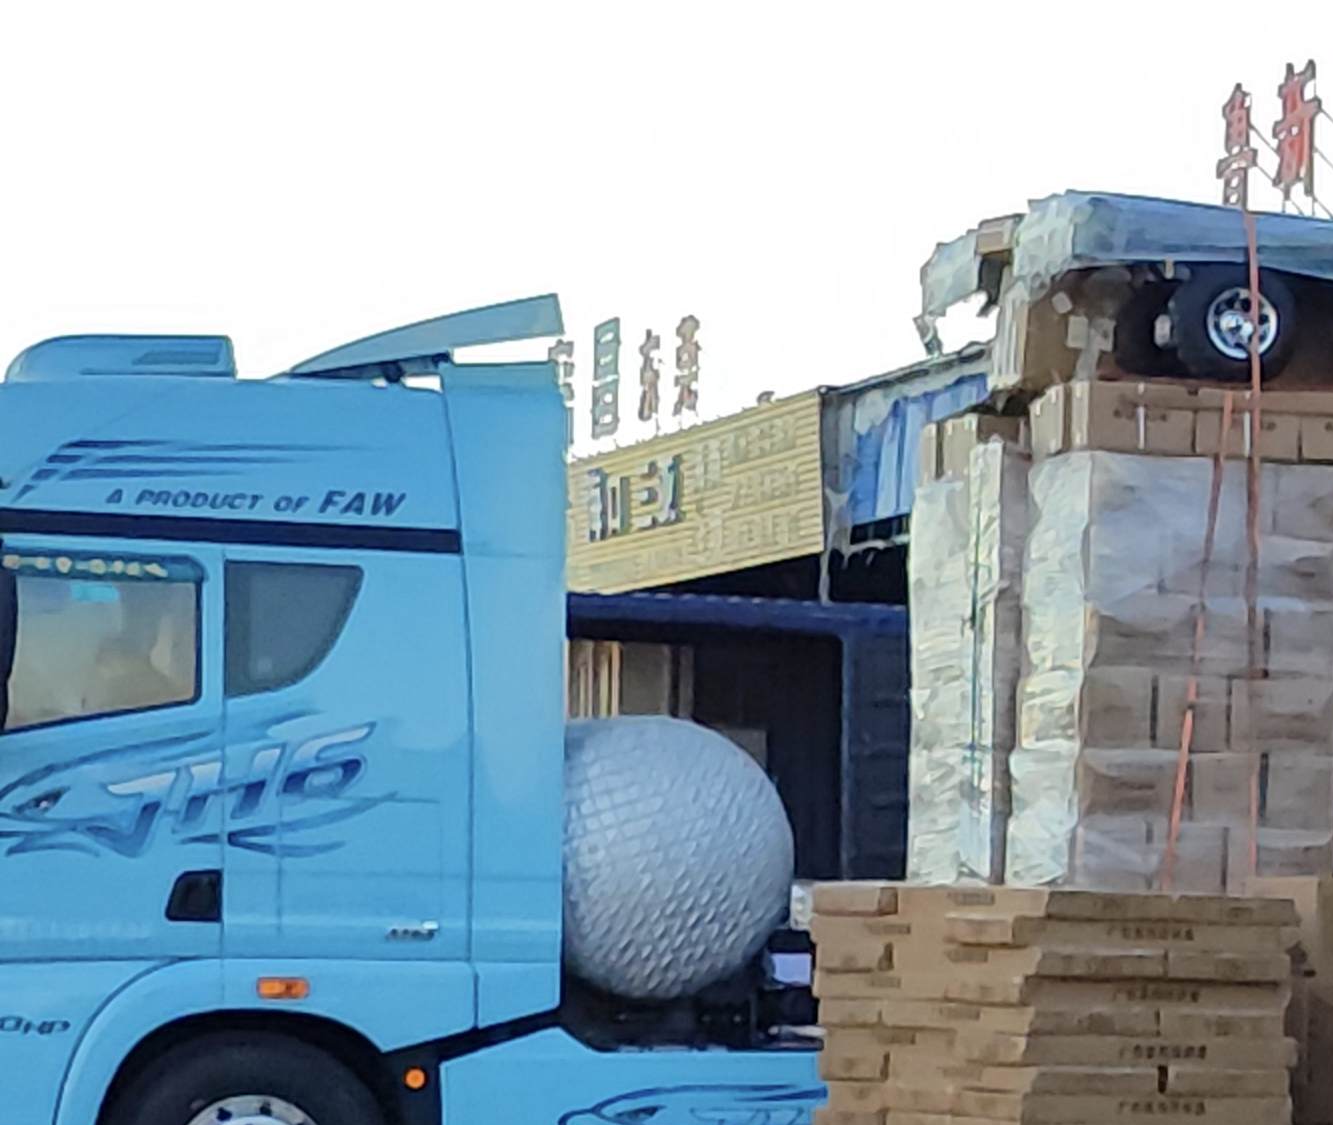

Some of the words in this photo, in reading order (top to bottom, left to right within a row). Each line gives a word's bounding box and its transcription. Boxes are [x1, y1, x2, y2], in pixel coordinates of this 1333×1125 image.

[106, 489, 125, 504] A
[135, 490, 262, 511] PRODUCT
[318, 490, 407, 517] FAW
